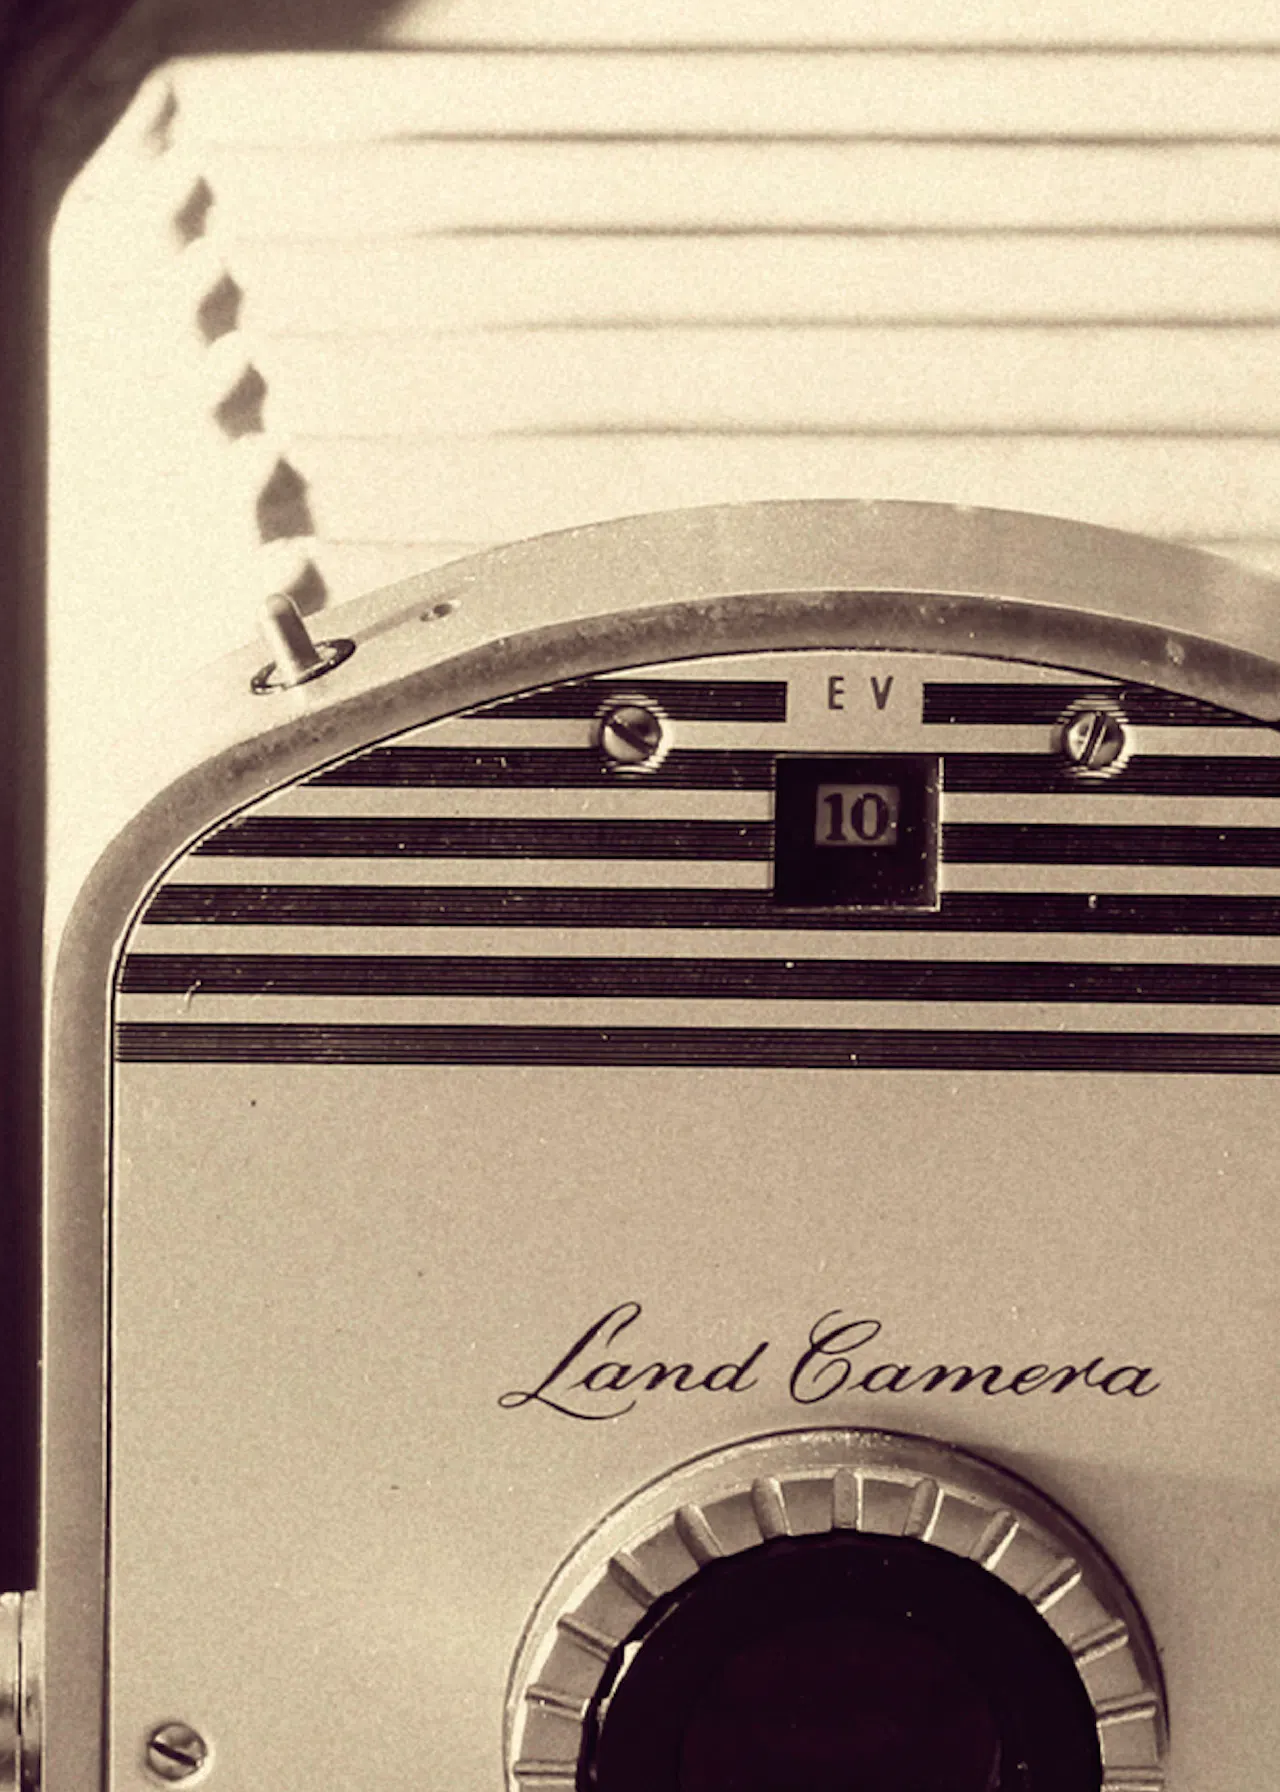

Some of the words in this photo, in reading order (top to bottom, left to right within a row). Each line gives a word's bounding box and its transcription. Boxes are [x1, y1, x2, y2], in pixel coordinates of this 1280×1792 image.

[822, 791, 892, 842] 10
[497, 1300, 770, 1420] Land
[787, 1308, 1161, 1404] Camera
